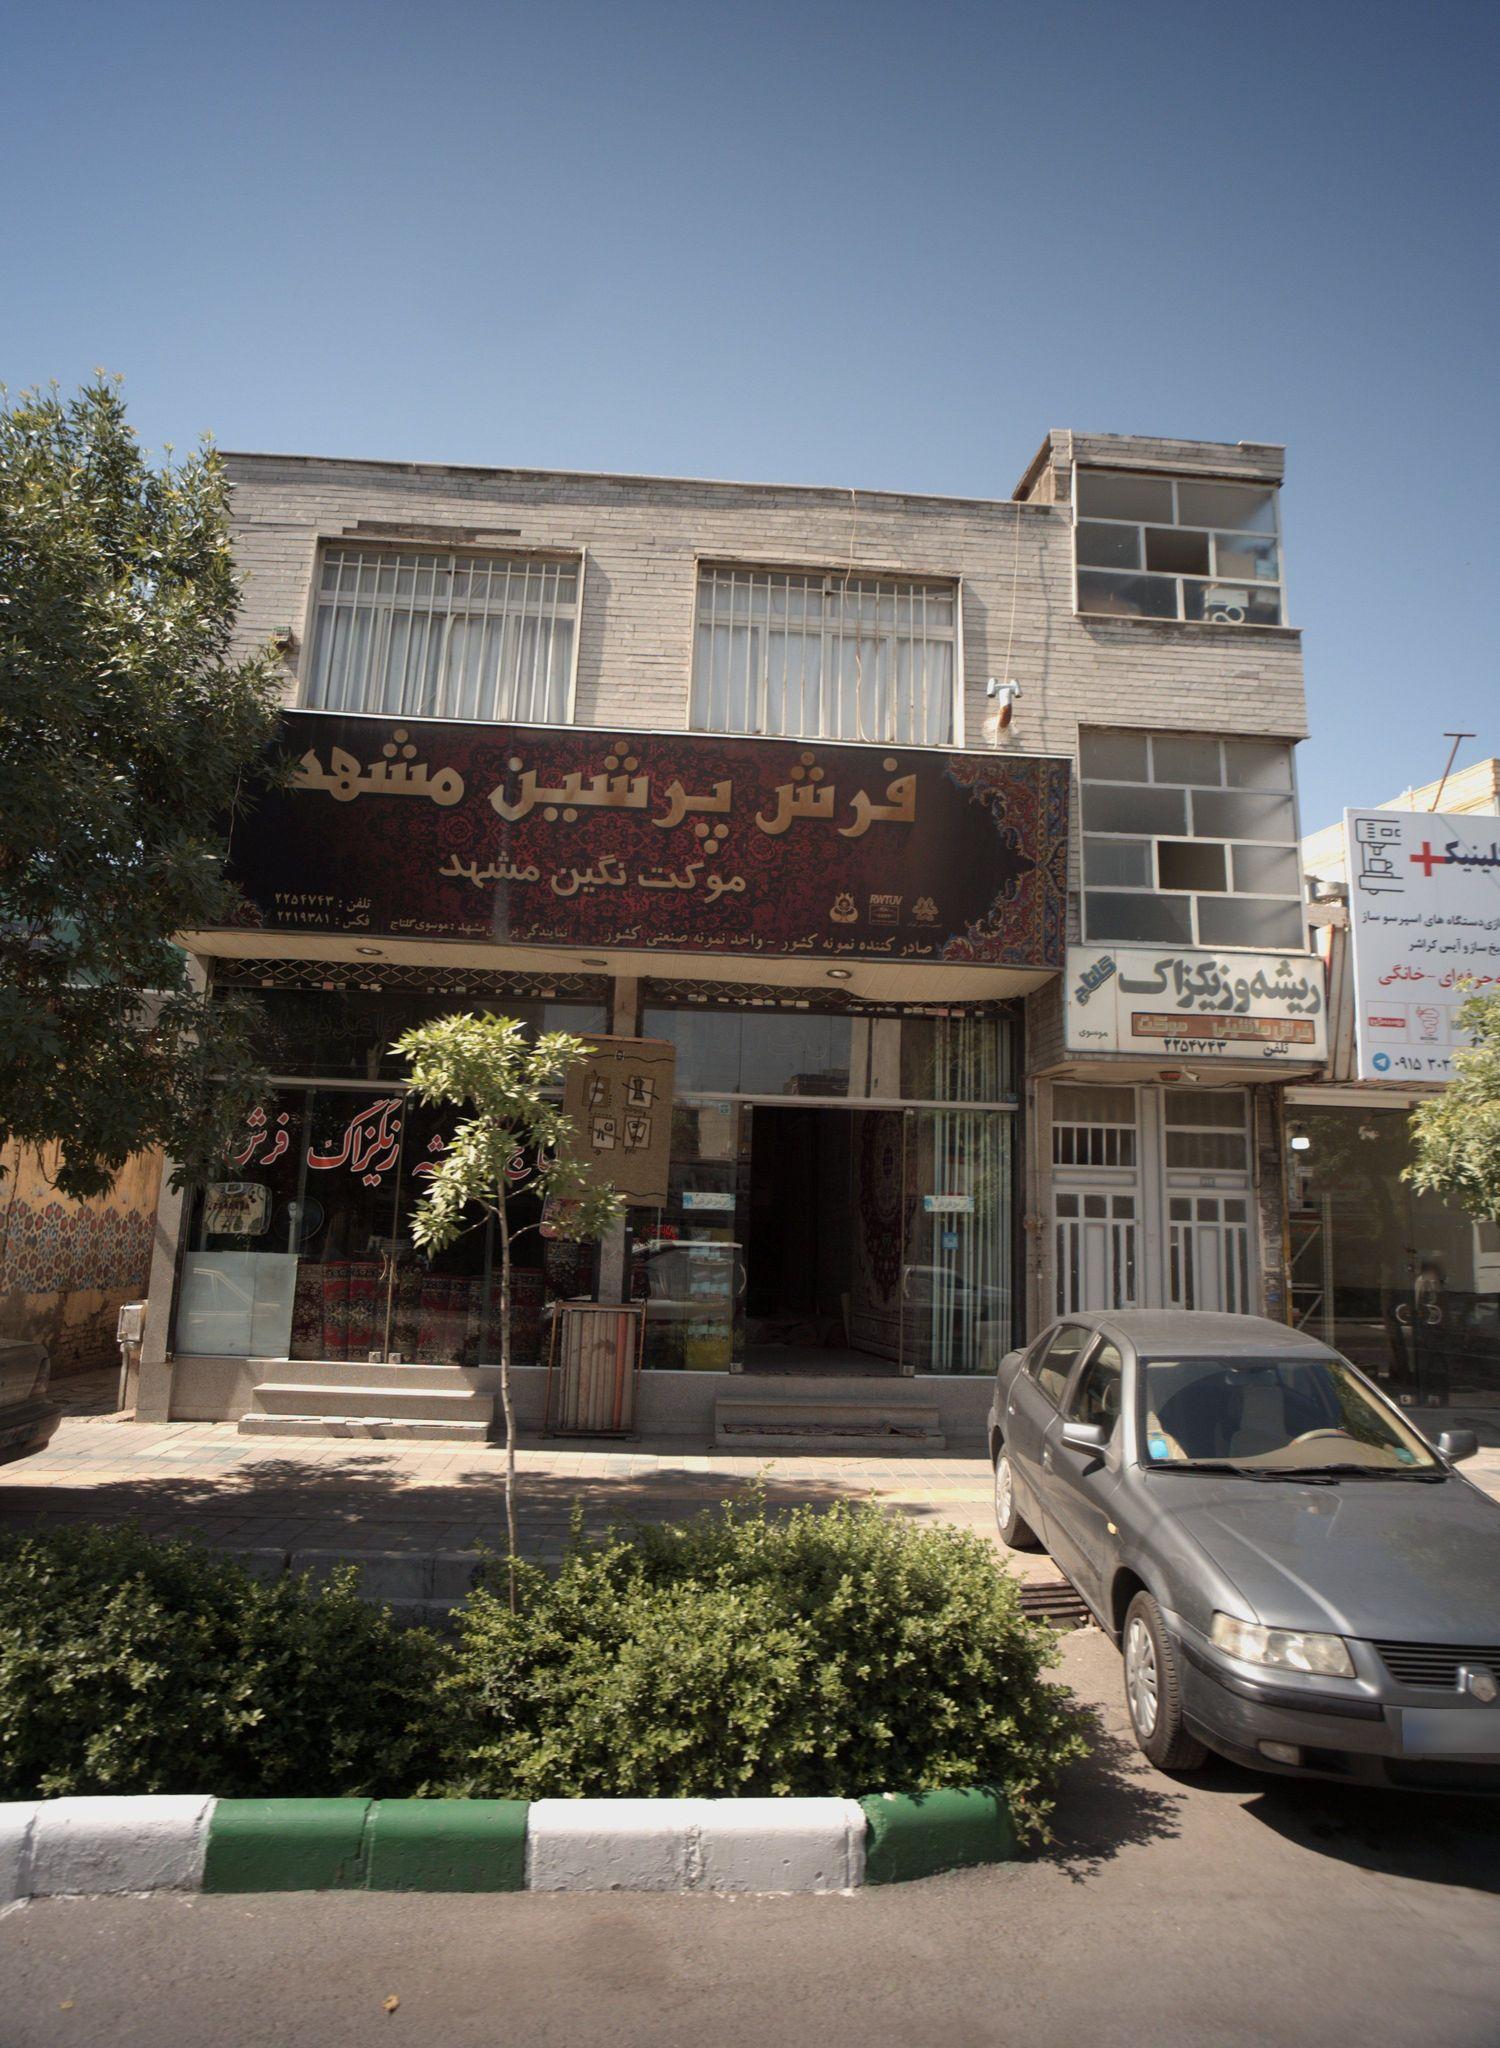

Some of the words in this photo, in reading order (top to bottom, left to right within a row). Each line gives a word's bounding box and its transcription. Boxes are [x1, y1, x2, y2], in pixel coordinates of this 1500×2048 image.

[284, 729, 465, 807] مشهد
[488, 740, 733, 855] پرشین
[755, 750, 917, 838] فرش
[439, 851, 541, 890] مشهد
[551, 854, 627, 897] نگین
[639, 862, 746, 904] موکت
[604, 925, 642, 944] کشور
[693, 932, 726, 948] نمونه
[731, 932, 763, 950] واحد
[781, 933, 818, 952] کشور
[859, 936, 896, 952] کننده
[822, 938, 855, 954] نمونه
[900, 940, 933, 957] صادر
[1263, 1043, 1289, 1058] تلفن
